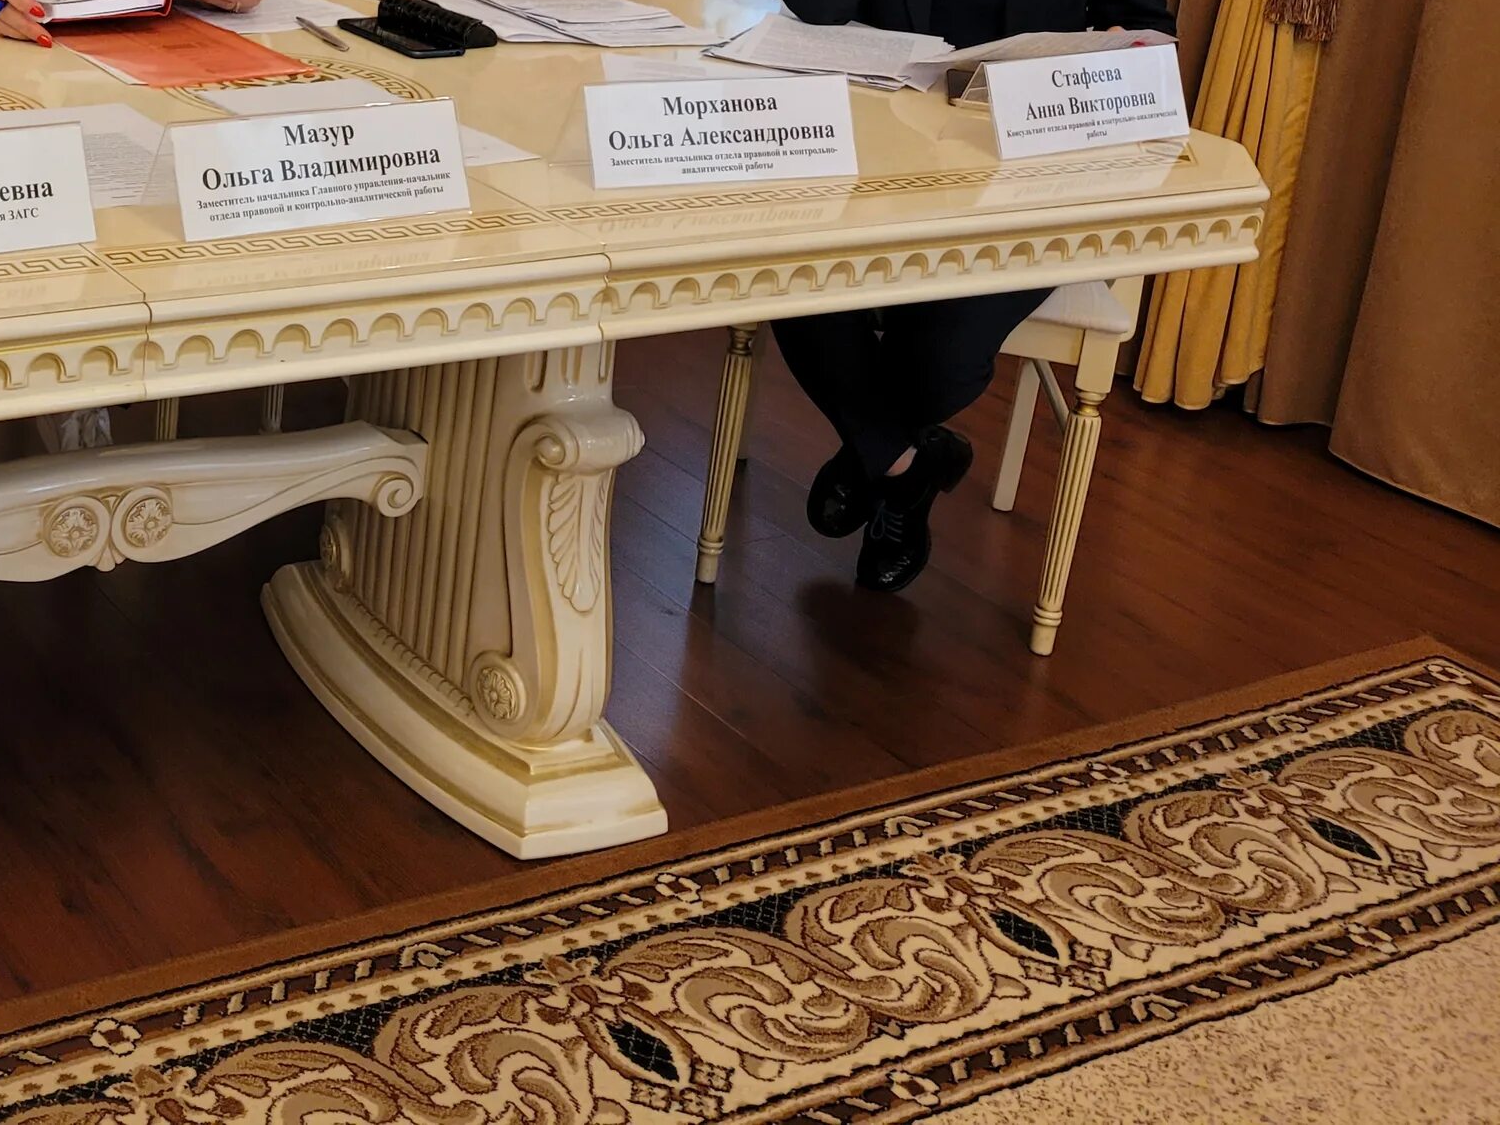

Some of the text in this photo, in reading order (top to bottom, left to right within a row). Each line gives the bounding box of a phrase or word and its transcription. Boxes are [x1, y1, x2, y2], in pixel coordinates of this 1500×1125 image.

[1051, 67, 1123, 90] Стафеева
[661, 96, 779, 120] Морханова
[1026, 91, 1157, 121] Анна Викторовна
[281, 123, 354, 147] Мазур
[608, 122, 837, 151] Ольга Александровна
[202, 148, 441, 191] Ольга Владимировна
[196, 196, 255, 210] Заместитель
[256, 189, 310, 203] начальника
[311, 184, 353, 196] Главного
[209, 211, 241, 222] отдела
[242, 205, 285, 220] правовой
[413, 185, 444, 198] работы
[7, 206, 40, 221] ЗАГС
